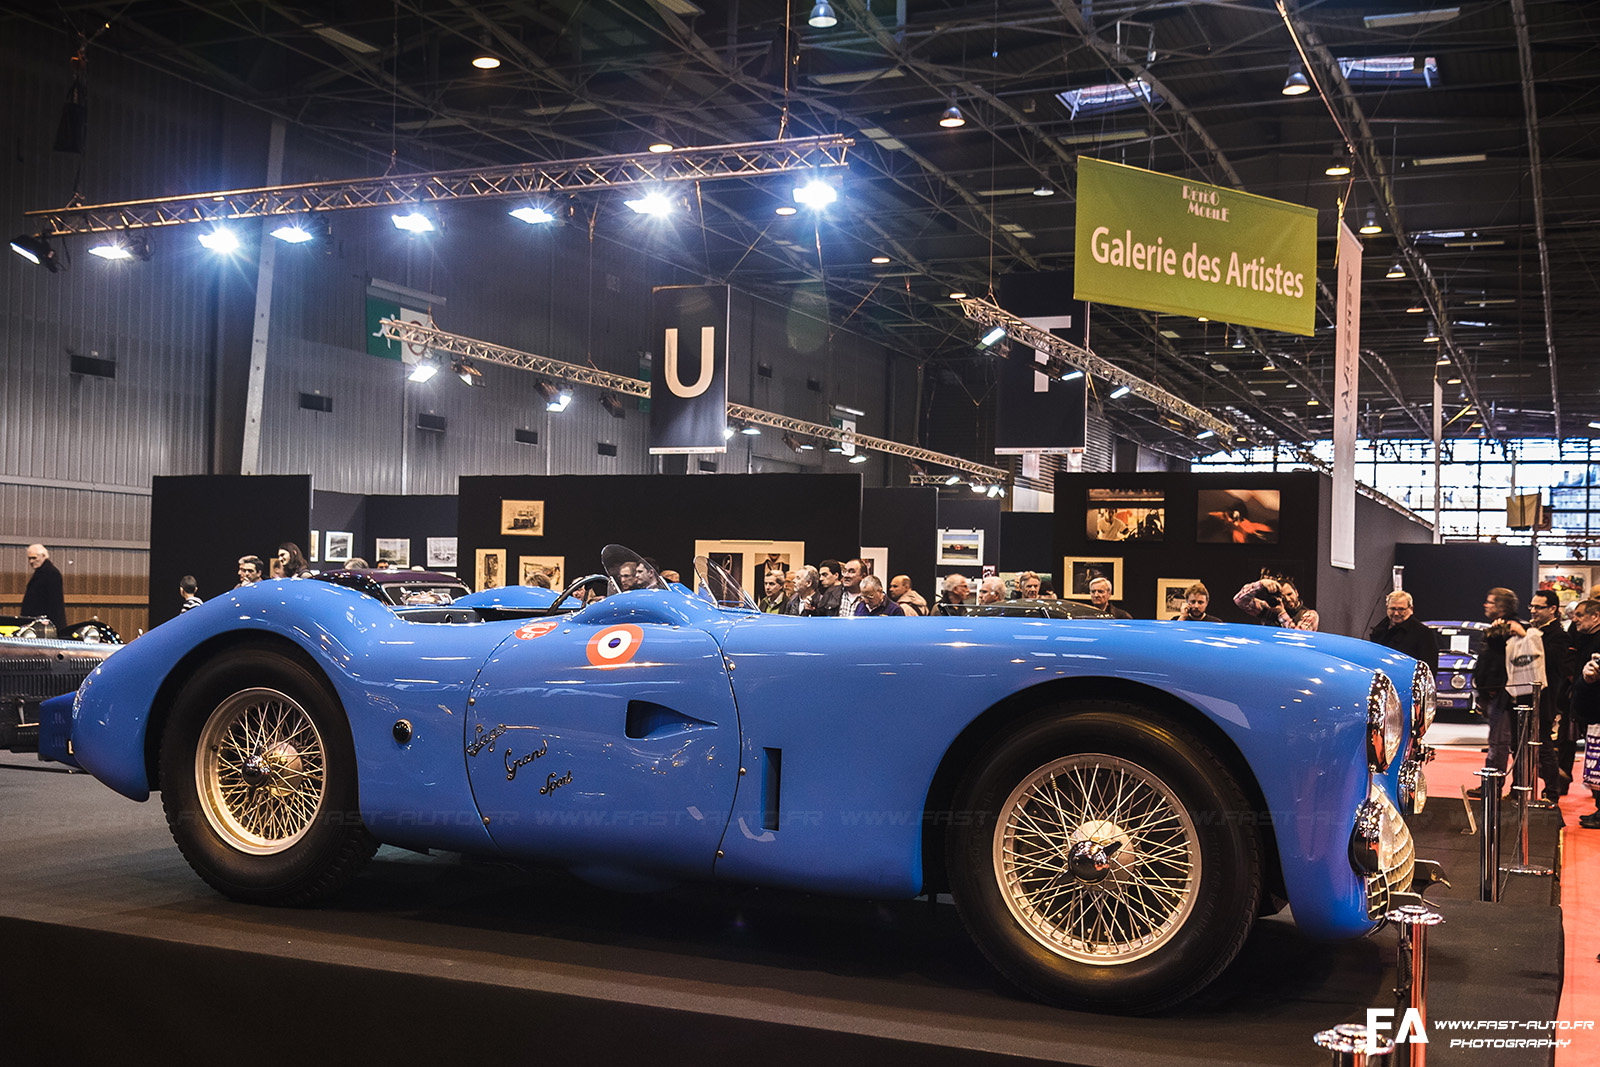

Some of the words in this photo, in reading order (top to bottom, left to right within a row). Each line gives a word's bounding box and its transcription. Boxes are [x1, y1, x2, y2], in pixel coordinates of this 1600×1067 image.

[1187, 201, 1230, 222] MOBILE
[1091, 226, 1176, 276] Galerie
[1182, 243, 1221, 283] des
[1226, 252, 1304, 298] Artistes
[664, 326, 715, 398] U
[466, 722, 506, 757] Lago
[504, 739, 548, 782] Grand
[539, 769, 573, 796] Sport
